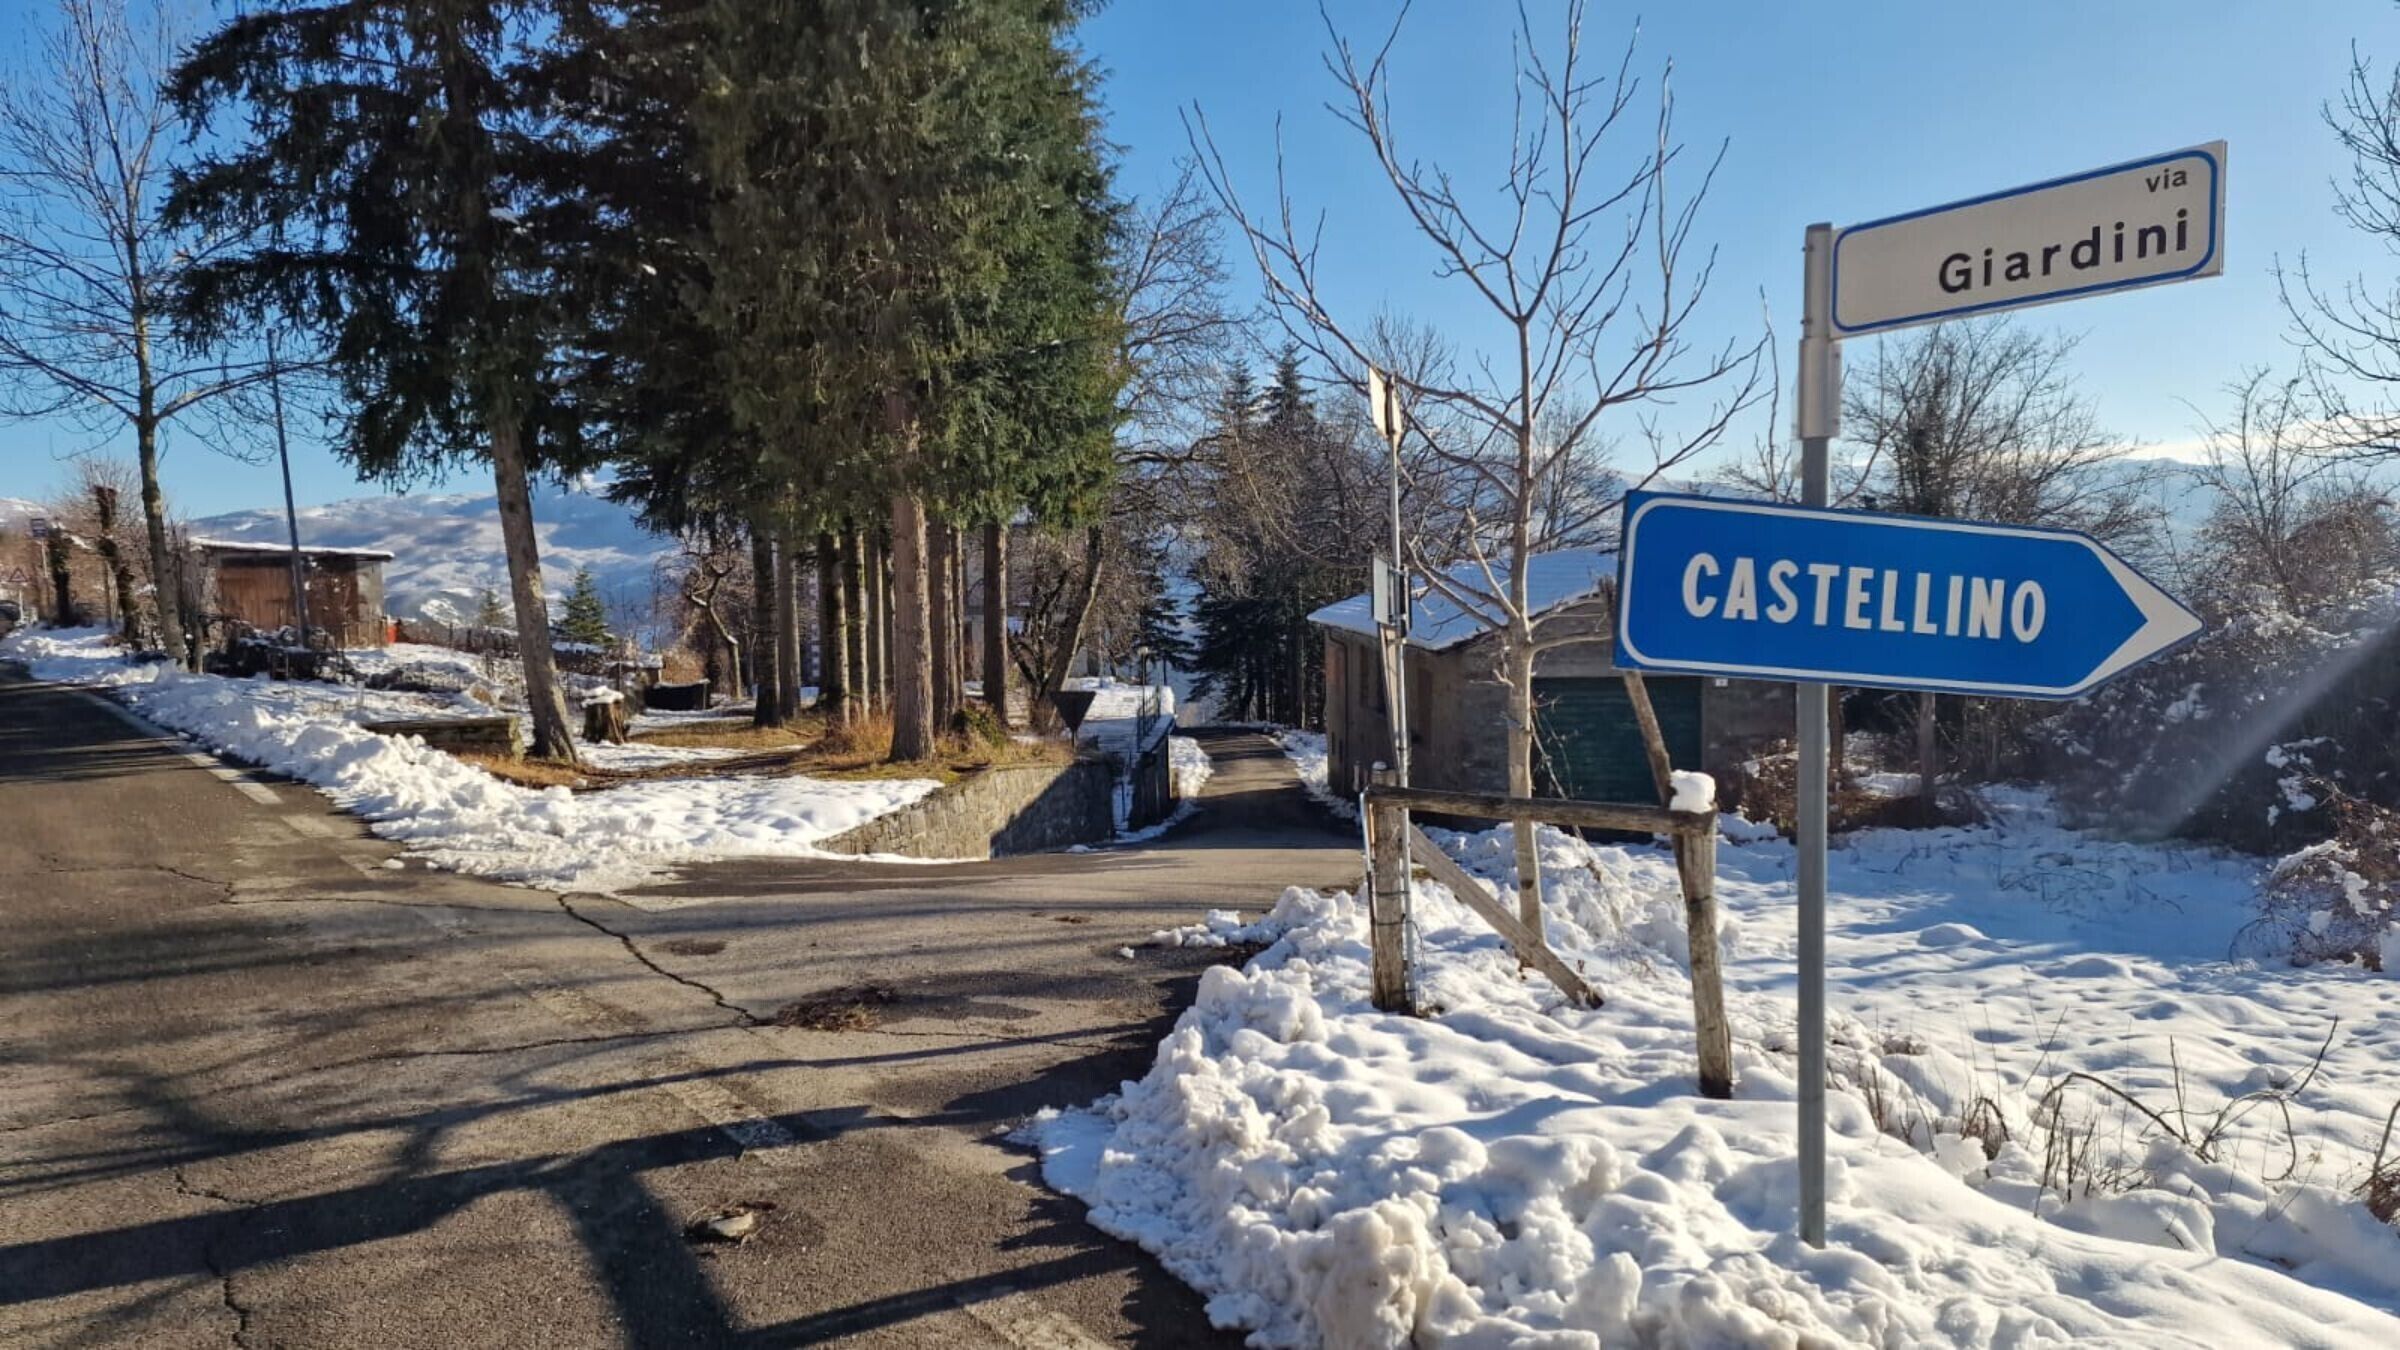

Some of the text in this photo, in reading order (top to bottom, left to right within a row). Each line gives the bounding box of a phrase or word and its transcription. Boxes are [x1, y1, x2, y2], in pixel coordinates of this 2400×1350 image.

[2145, 168, 2188, 193] via
[1938, 208, 2188, 294] Giardini
[1682, 552, 2047, 643] CASTELLINO
